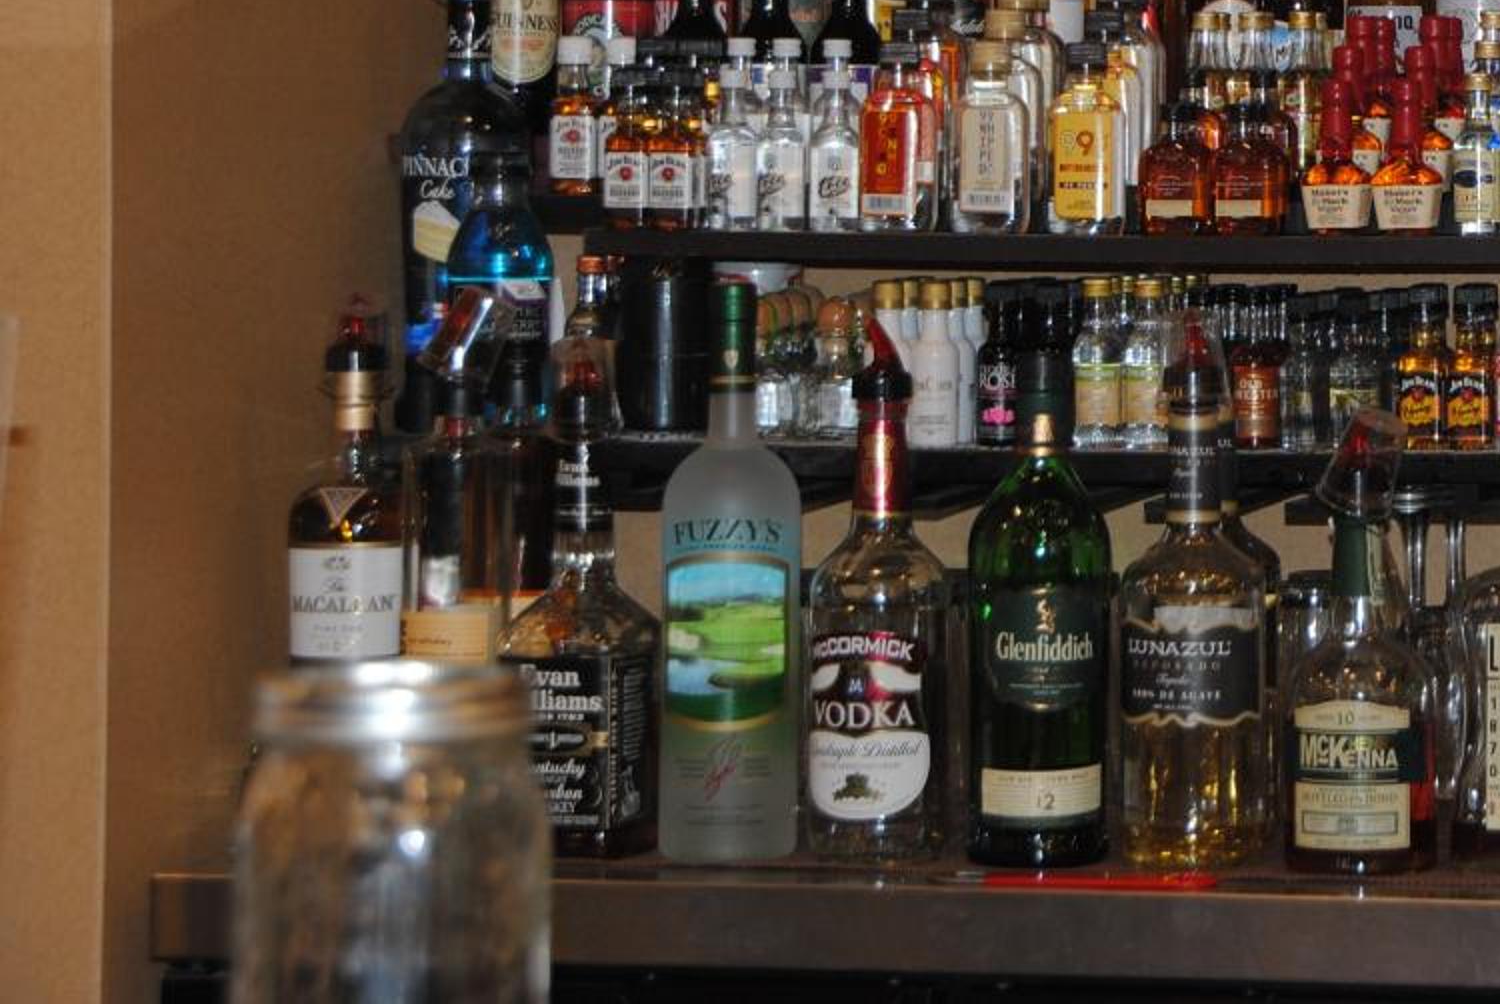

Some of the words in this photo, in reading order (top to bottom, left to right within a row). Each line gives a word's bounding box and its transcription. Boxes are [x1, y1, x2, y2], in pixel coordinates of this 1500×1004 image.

[996, 630, 1093, 662] Glenfiddich
[1128, 637, 1233, 658] LUNAZUL
[814, 700, 916, 729] VODKA
